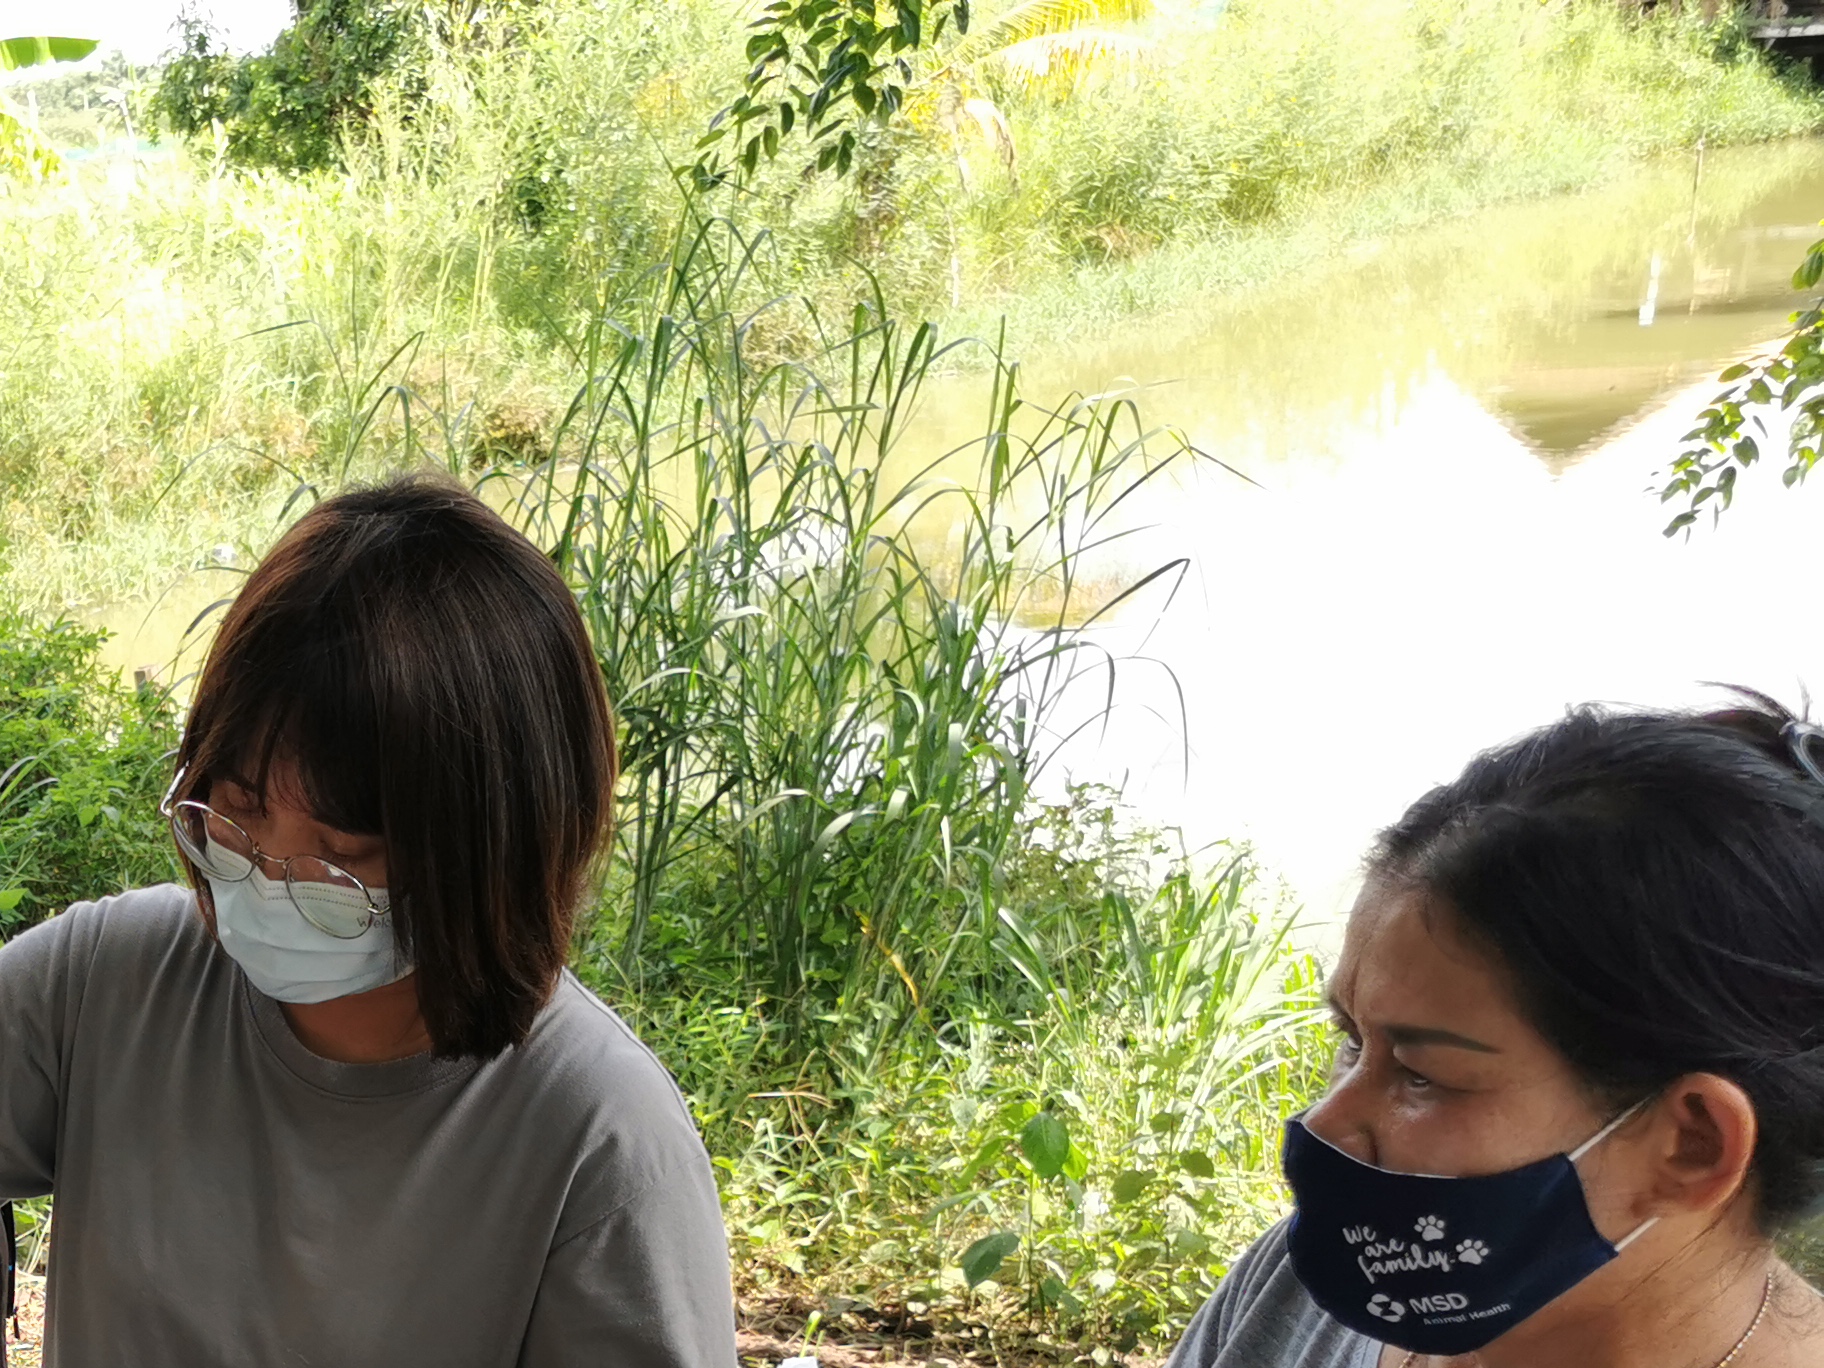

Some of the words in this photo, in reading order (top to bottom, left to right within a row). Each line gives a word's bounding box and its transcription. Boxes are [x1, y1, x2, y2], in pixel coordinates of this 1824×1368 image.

[1364, 1238, 1405, 1258] are
[1408, 1293, 1469, 1314] MSD
[1423, 1313, 1467, 1326] Animal
[1468, 1302, 1512, 1320] Health
